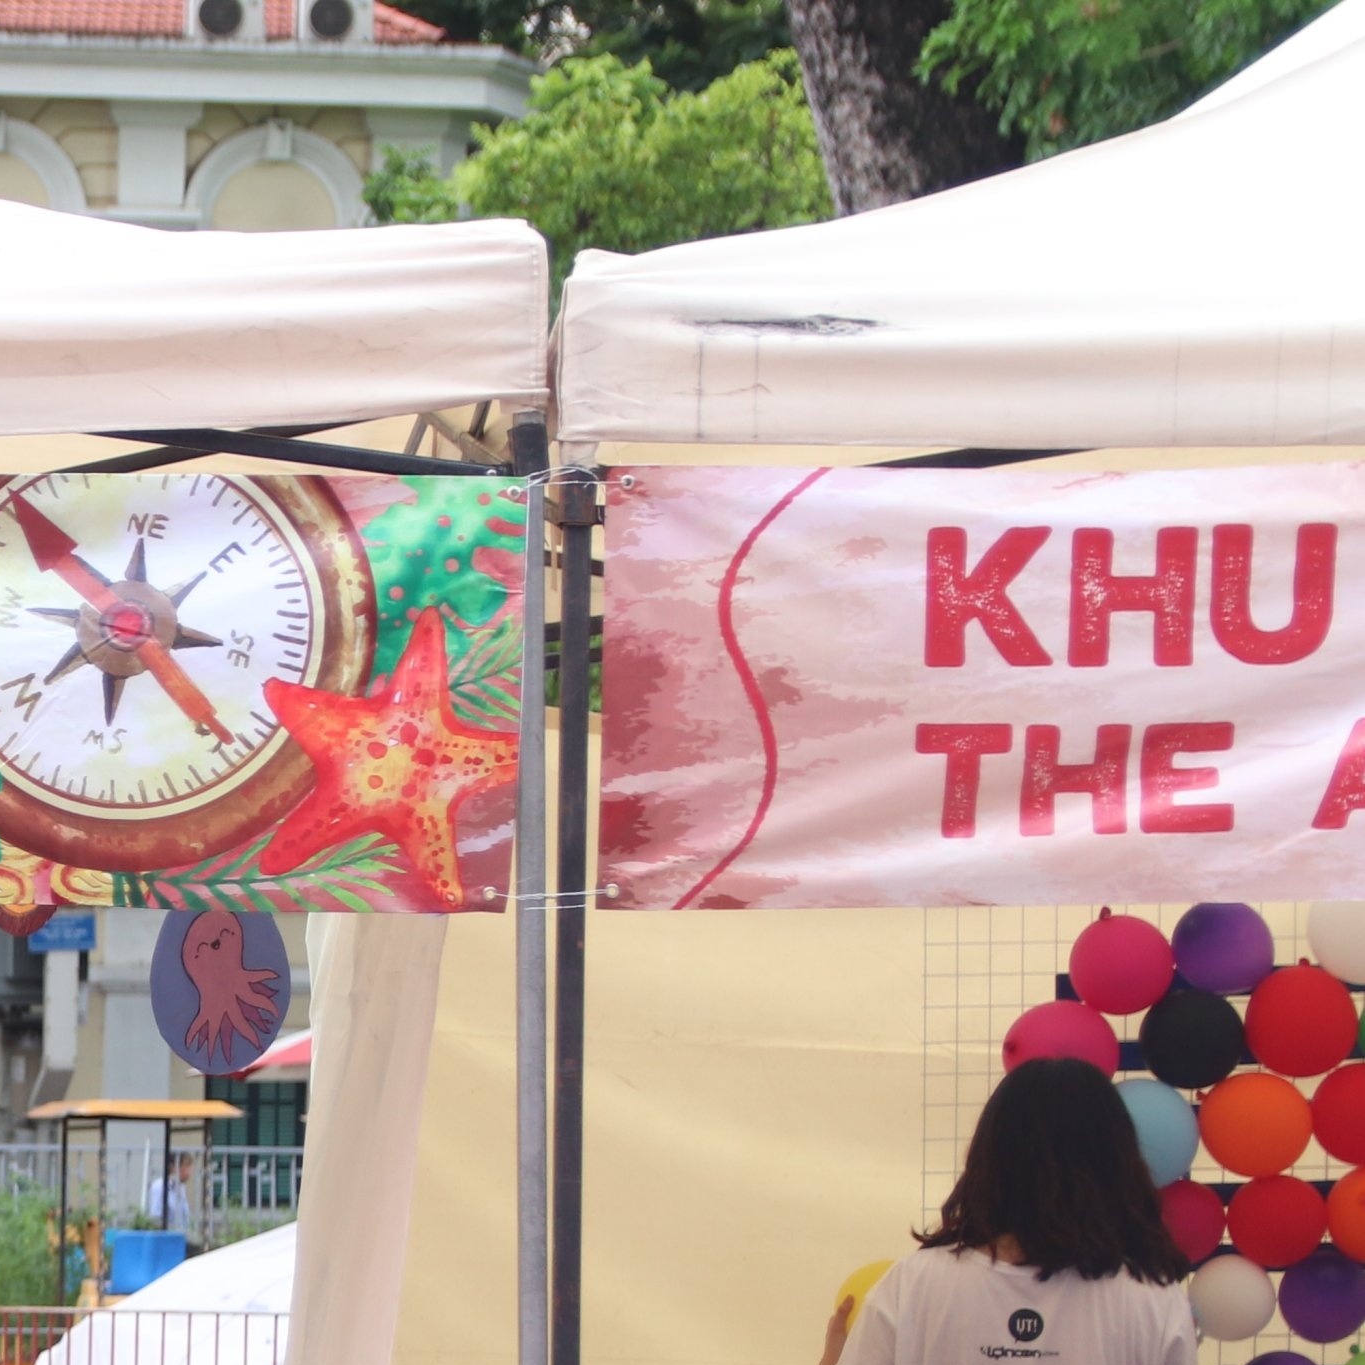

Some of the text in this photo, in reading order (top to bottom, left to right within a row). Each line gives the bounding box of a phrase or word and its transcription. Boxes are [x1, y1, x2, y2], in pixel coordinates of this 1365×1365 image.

[127, 512, 170, 540] NE
[924, 522, 1339, 668] KHU
[915, 721, 1236, 839] THE
